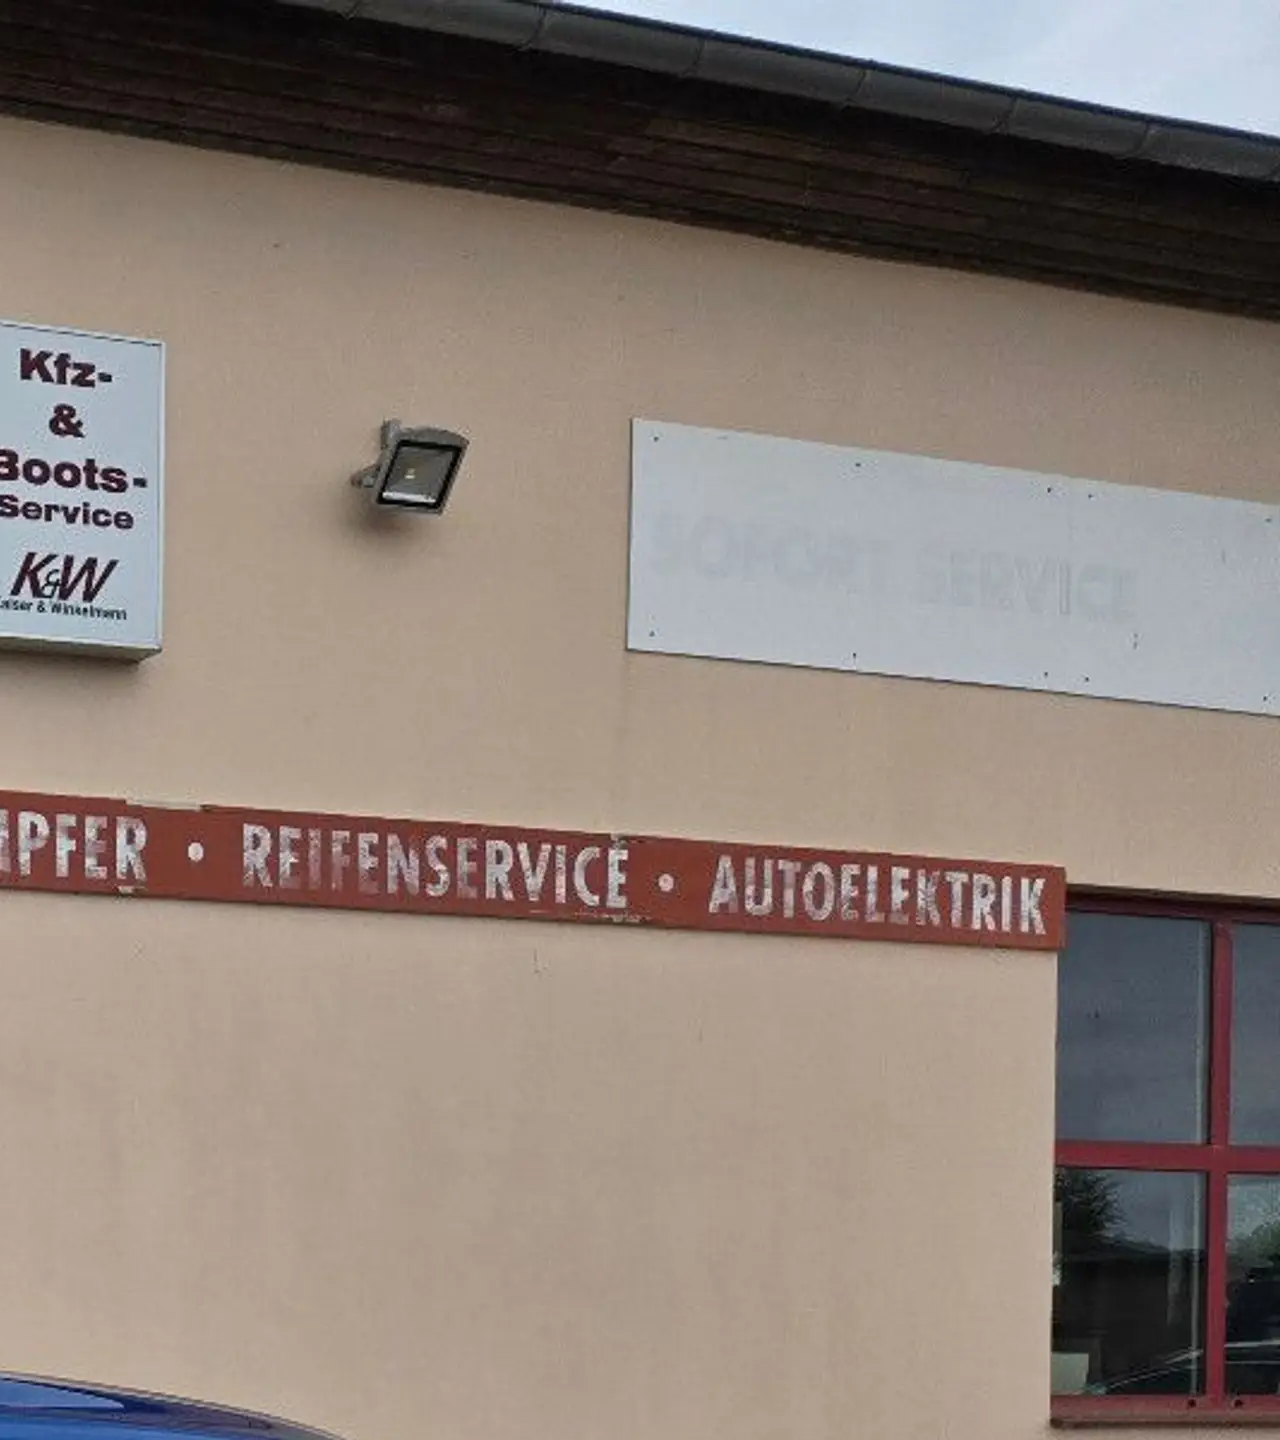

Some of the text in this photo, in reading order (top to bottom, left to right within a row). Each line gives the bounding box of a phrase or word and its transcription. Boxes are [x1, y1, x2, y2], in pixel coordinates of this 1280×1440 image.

[19, 347, 113, 388] Kfz-
[47, 403, 85, 438] &
[10, 551, 120, 601] K&W
[242, 822, 629, 909] REIFENSERVICE
[708, 854, 1047, 935] AUTOELEKTRIK
